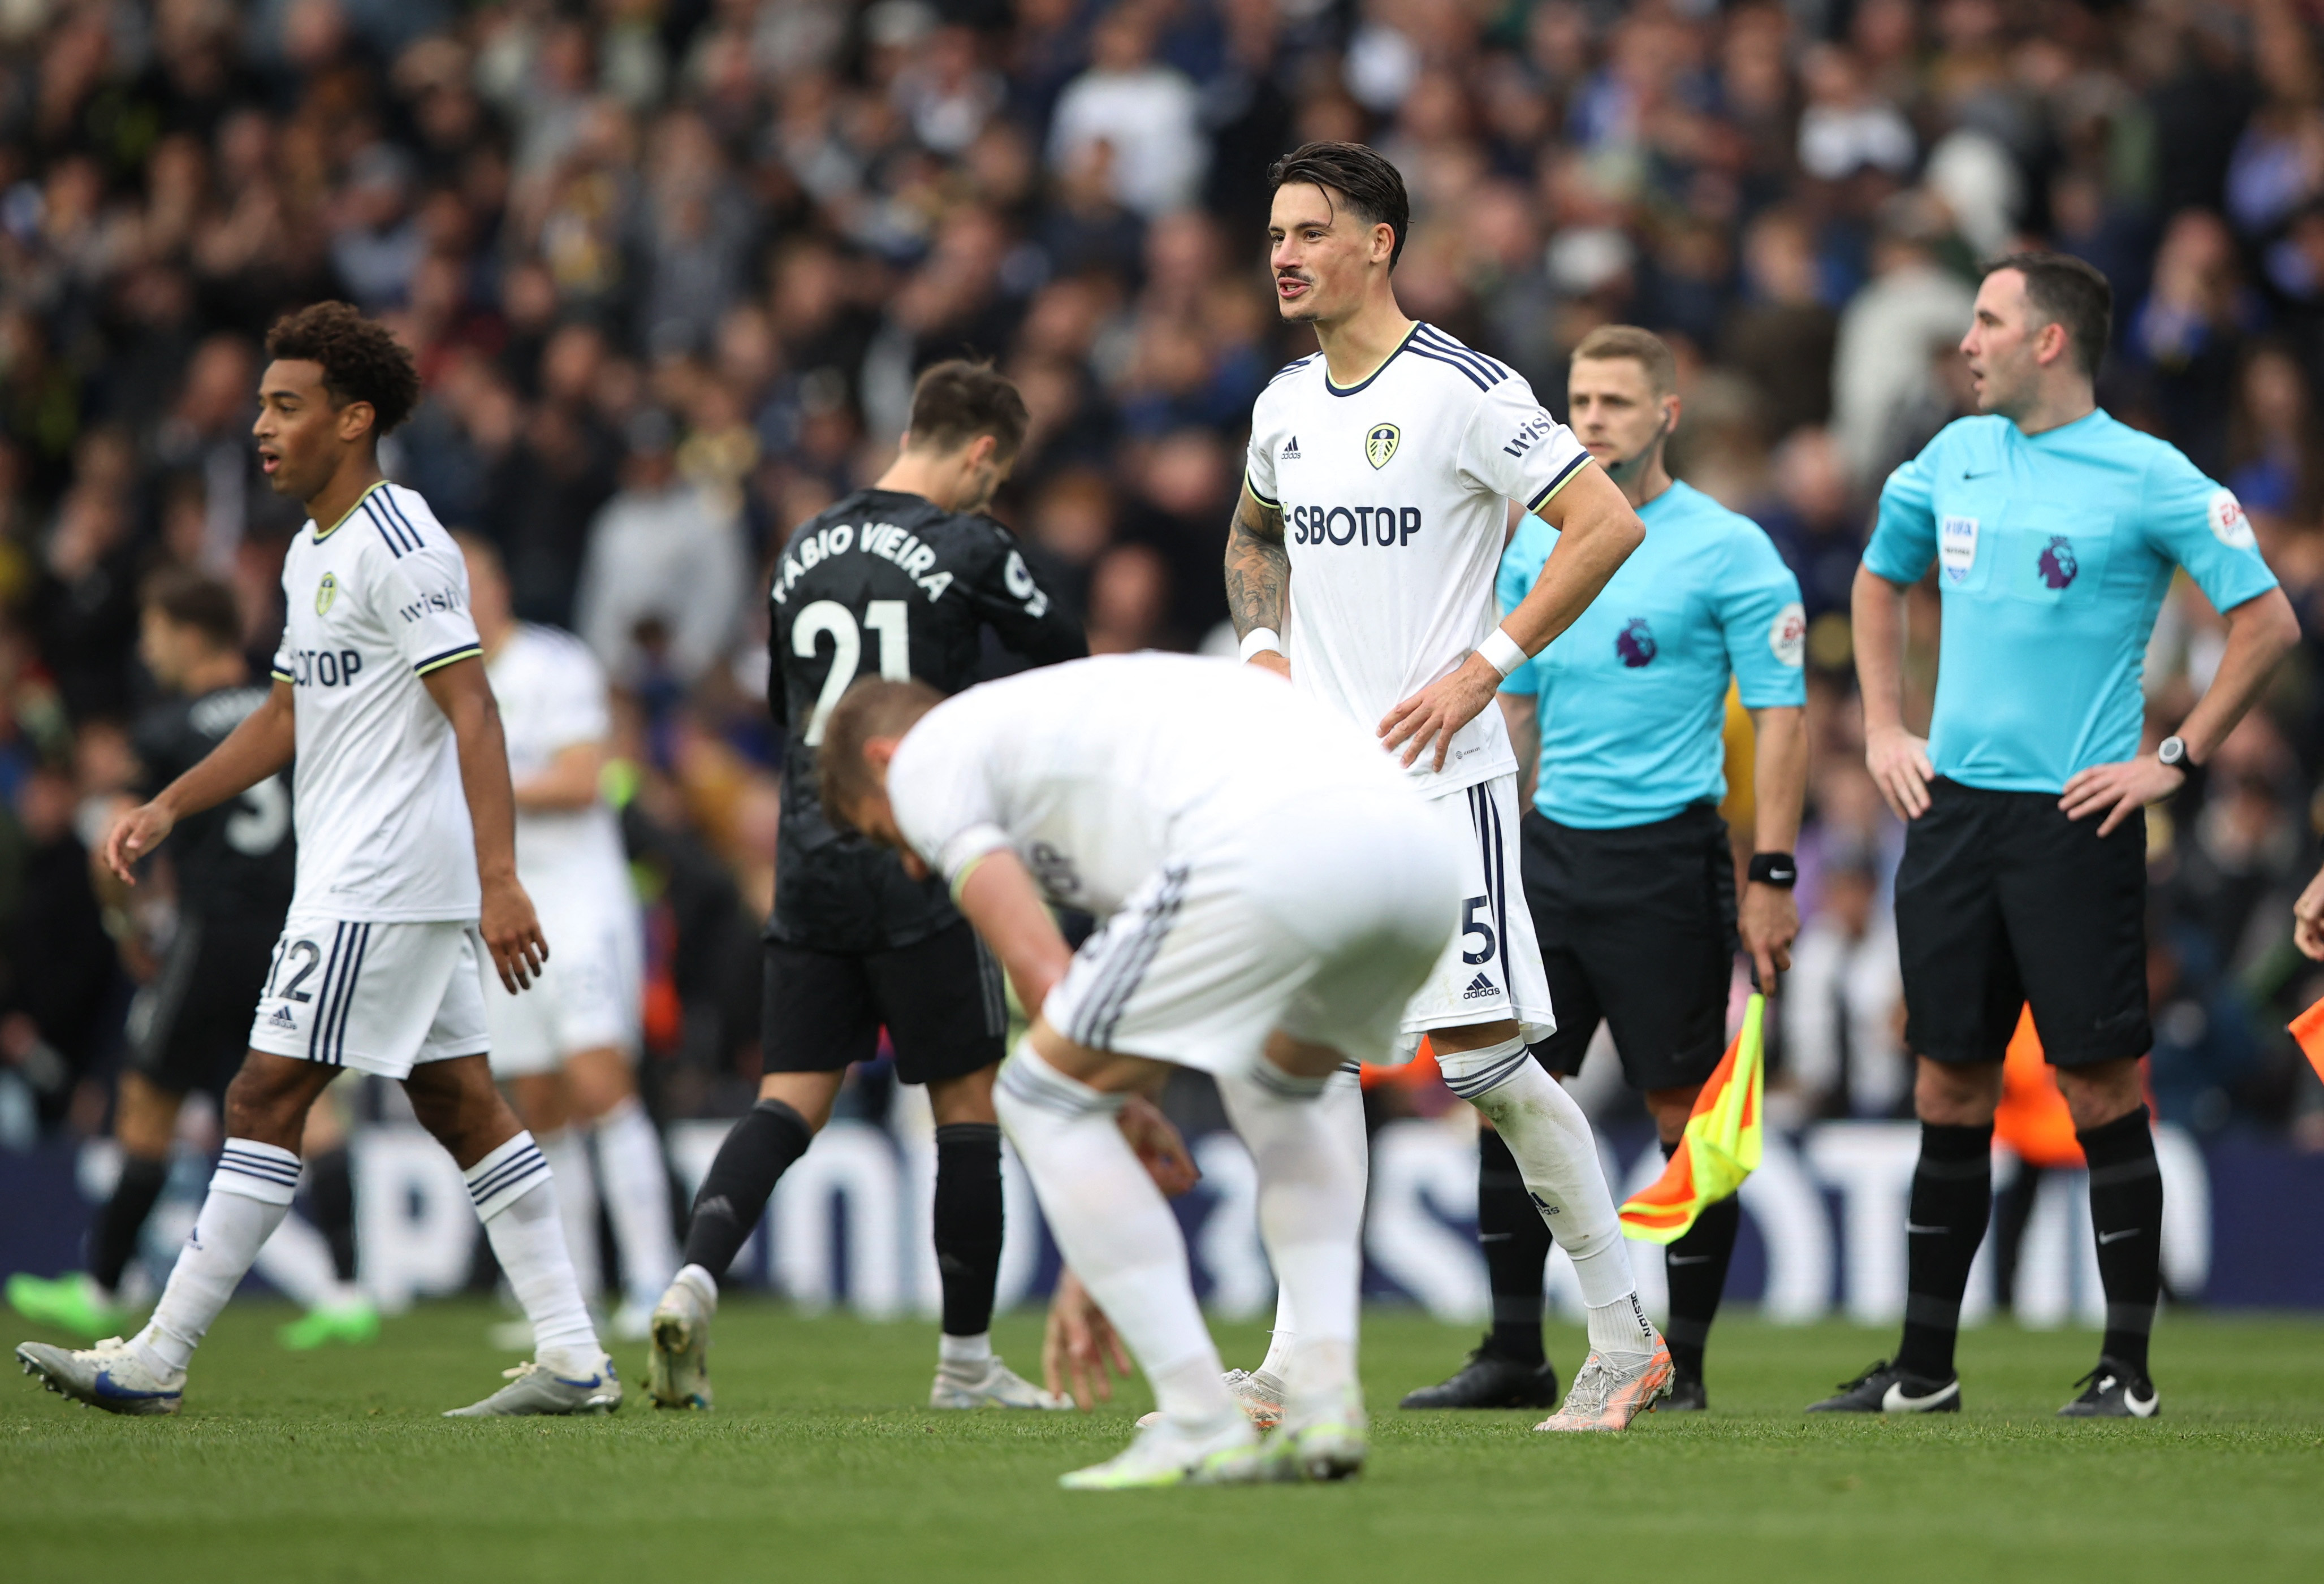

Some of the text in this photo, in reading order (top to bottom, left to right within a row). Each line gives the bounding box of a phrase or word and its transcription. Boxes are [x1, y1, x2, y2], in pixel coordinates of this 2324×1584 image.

[1281, 451, 1301, 460] adidas
[1294, 506, 1421, 546] SBOTOP
[859, 522, 954, 604] VIEIRA
[792, 600, 910, 746] 21
[1462, 895, 1496, 965] 5
[1463, 987, 1500, 999] adidas
[1631, 1291, 1652, 1337] DESIGN
